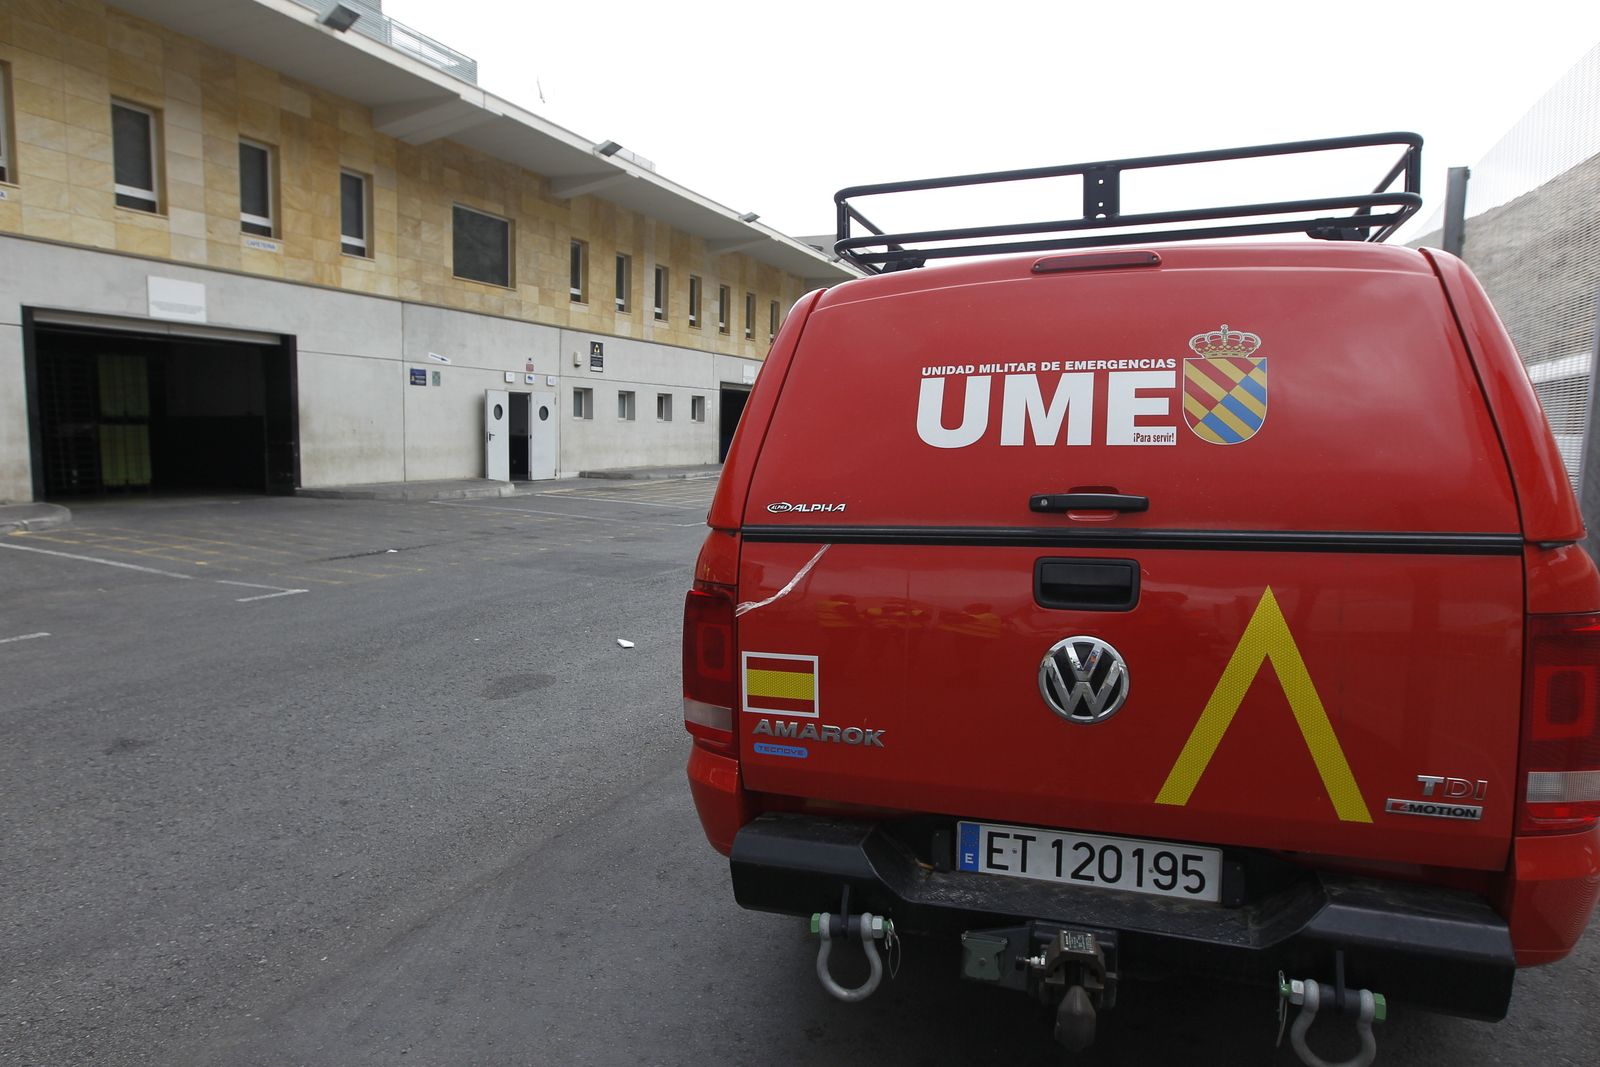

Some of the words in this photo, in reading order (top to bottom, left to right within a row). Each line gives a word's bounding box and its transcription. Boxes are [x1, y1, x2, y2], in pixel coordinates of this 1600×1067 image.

[921, 364, 975, 376] UNIDAD
[978, 361, 1036, 373] MILITAR
[1041, 361, 1060, 371] DE
[1065, 358, 1177, 370] EMERGENCIAS
[916, 371, 1177, 449] UME
[1133, 433, 1151, 443] ¡Para
[1153, 433, 1174, 442] servir!
[790, 503, 846, 512] ALPHA
[752, 719, 886, 748] AMAROK
[1417, 774, 1488, 801] TDI
[965, 853, 974, 864] E
[986, 831, 1036, 873] ET
[1051, 838, 1206, 894] 120195
